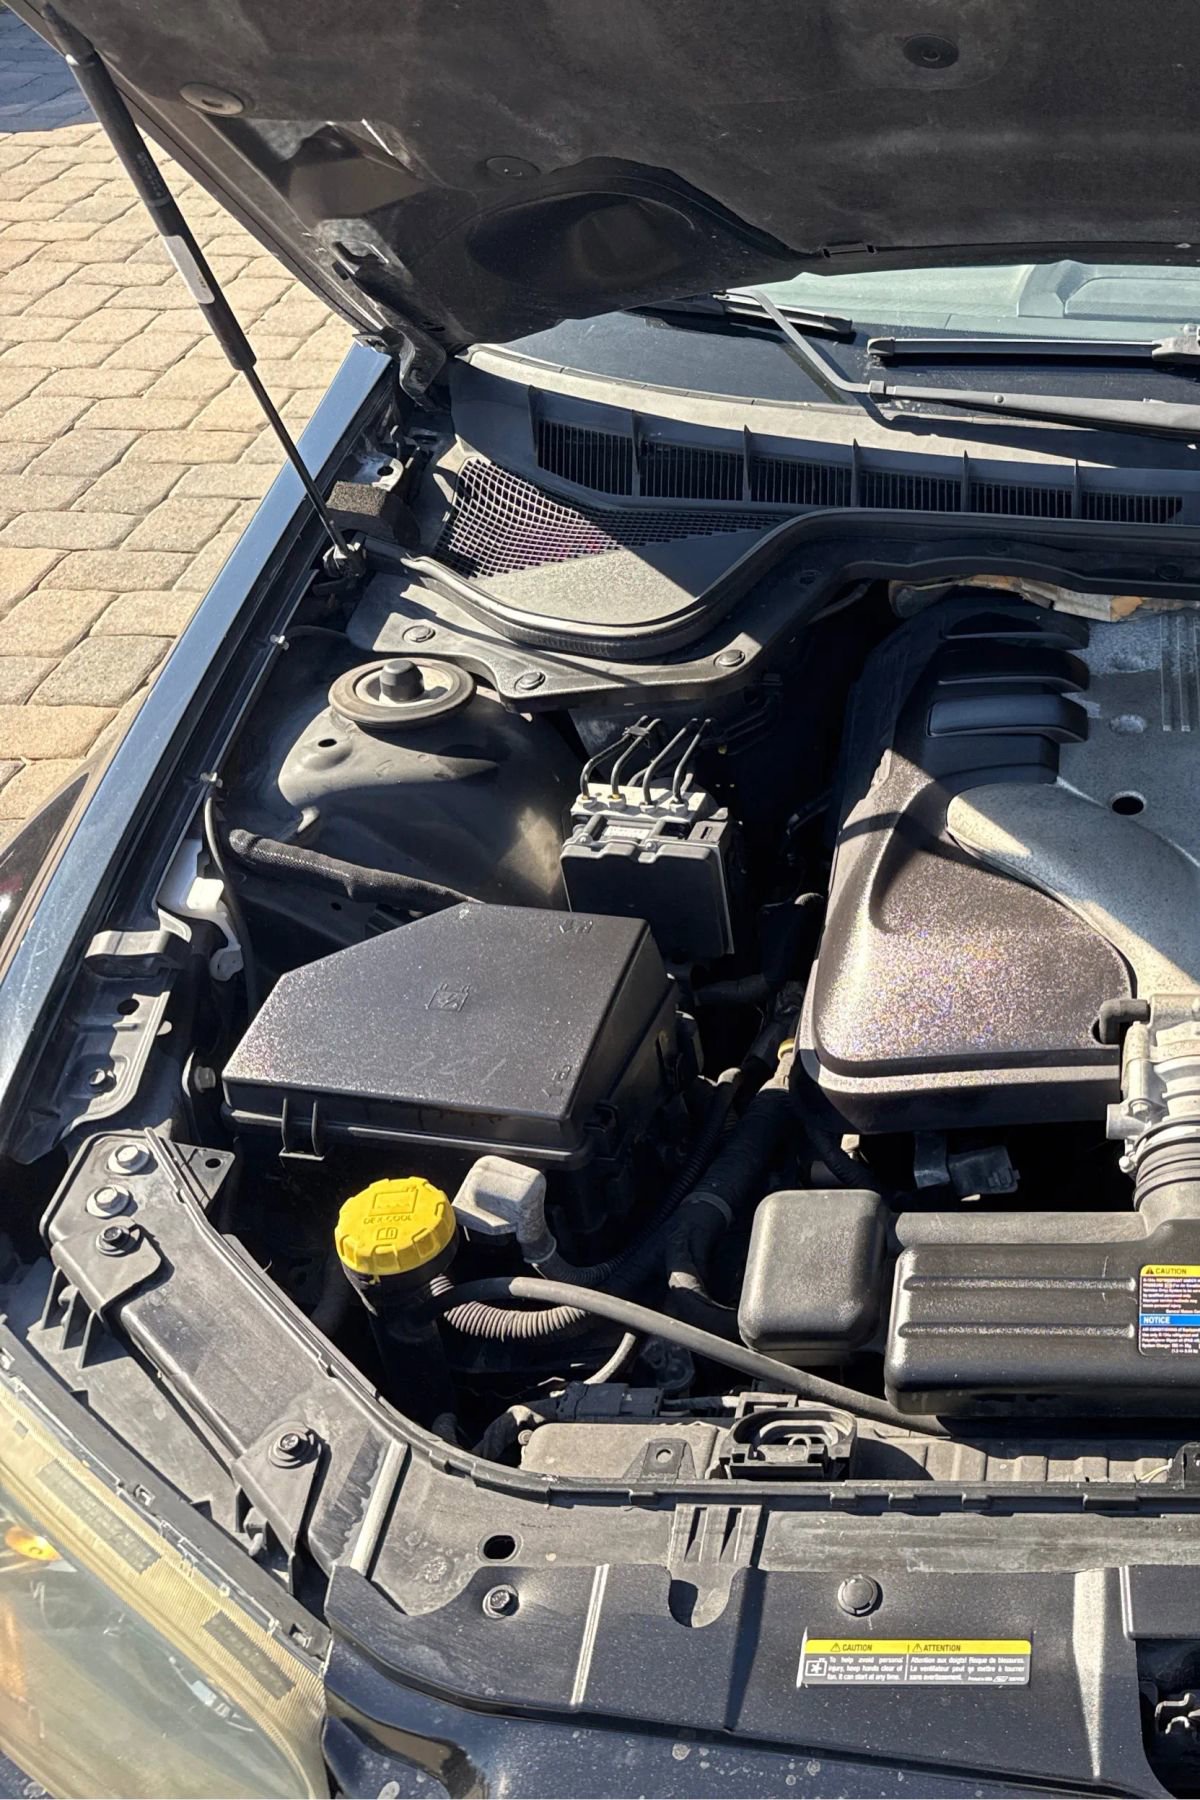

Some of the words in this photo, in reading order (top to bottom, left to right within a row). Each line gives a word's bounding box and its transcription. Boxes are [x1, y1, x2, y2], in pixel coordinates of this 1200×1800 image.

[1155, 1267, 1187, 1275] CAUTION
[1143, 1316, 1170, 1324] NOTICE
[842, 1644, 873, 1652] CAUTION
[923, 1644, 961, 1652] ATTENTION
